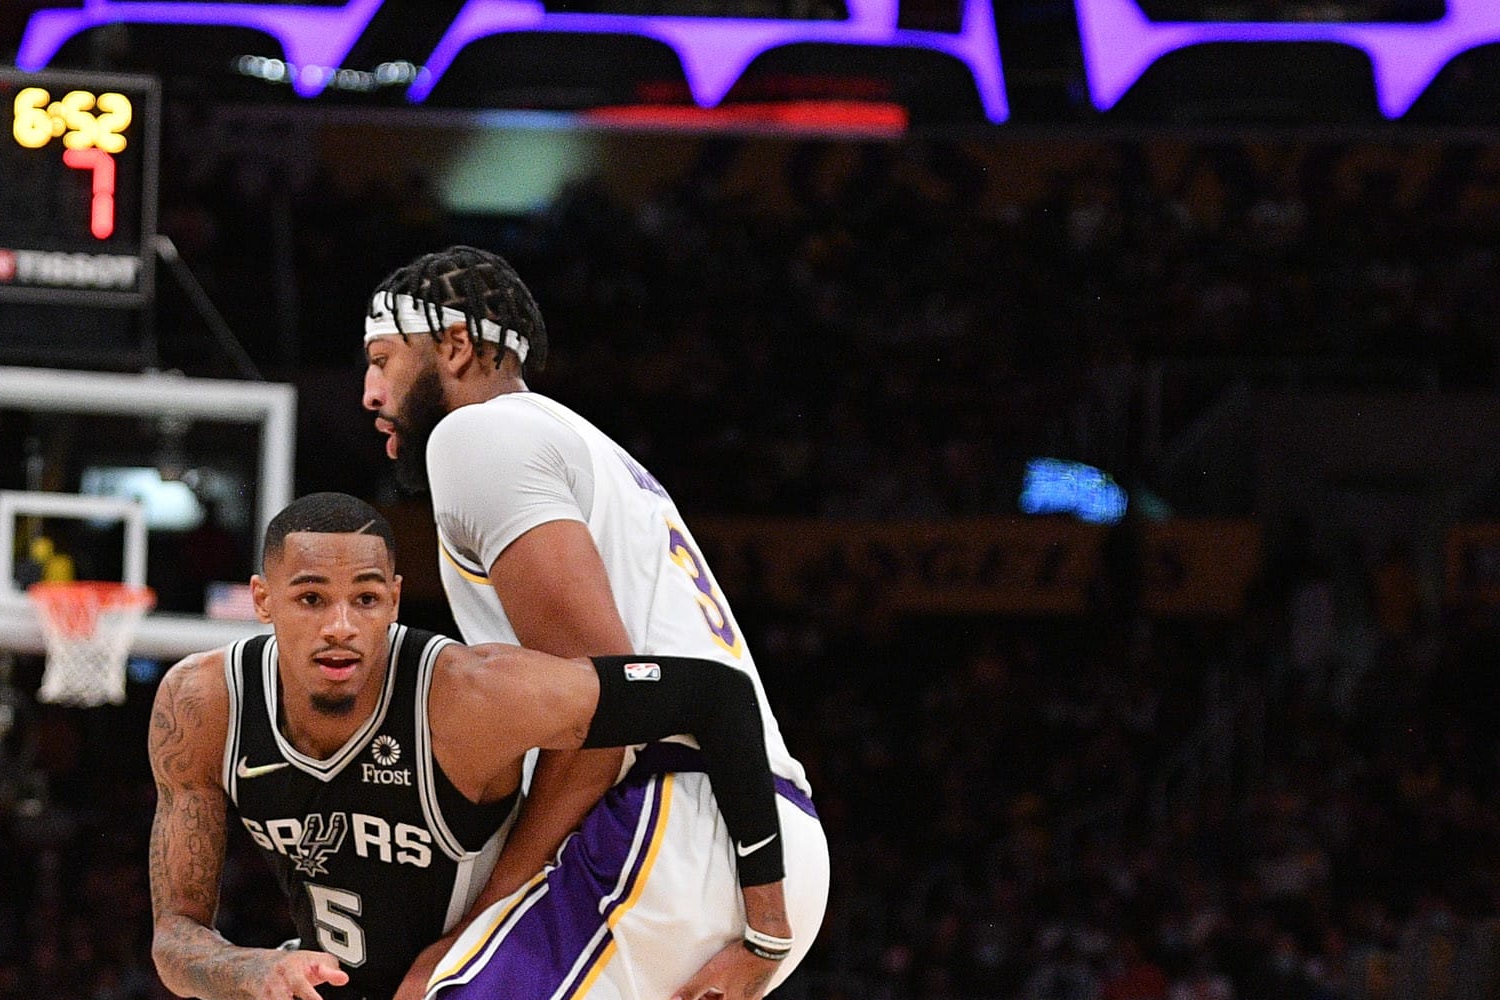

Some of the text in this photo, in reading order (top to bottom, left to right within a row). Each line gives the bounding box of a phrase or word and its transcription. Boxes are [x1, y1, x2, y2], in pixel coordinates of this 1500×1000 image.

[13, 87, 132, 153] 6:52
[62, 148, 115, 239] 7
[361, 763, 412, 787] Frost
[241, 812, 432, 877] SPURS
[304, 881, 367, 968] 5
